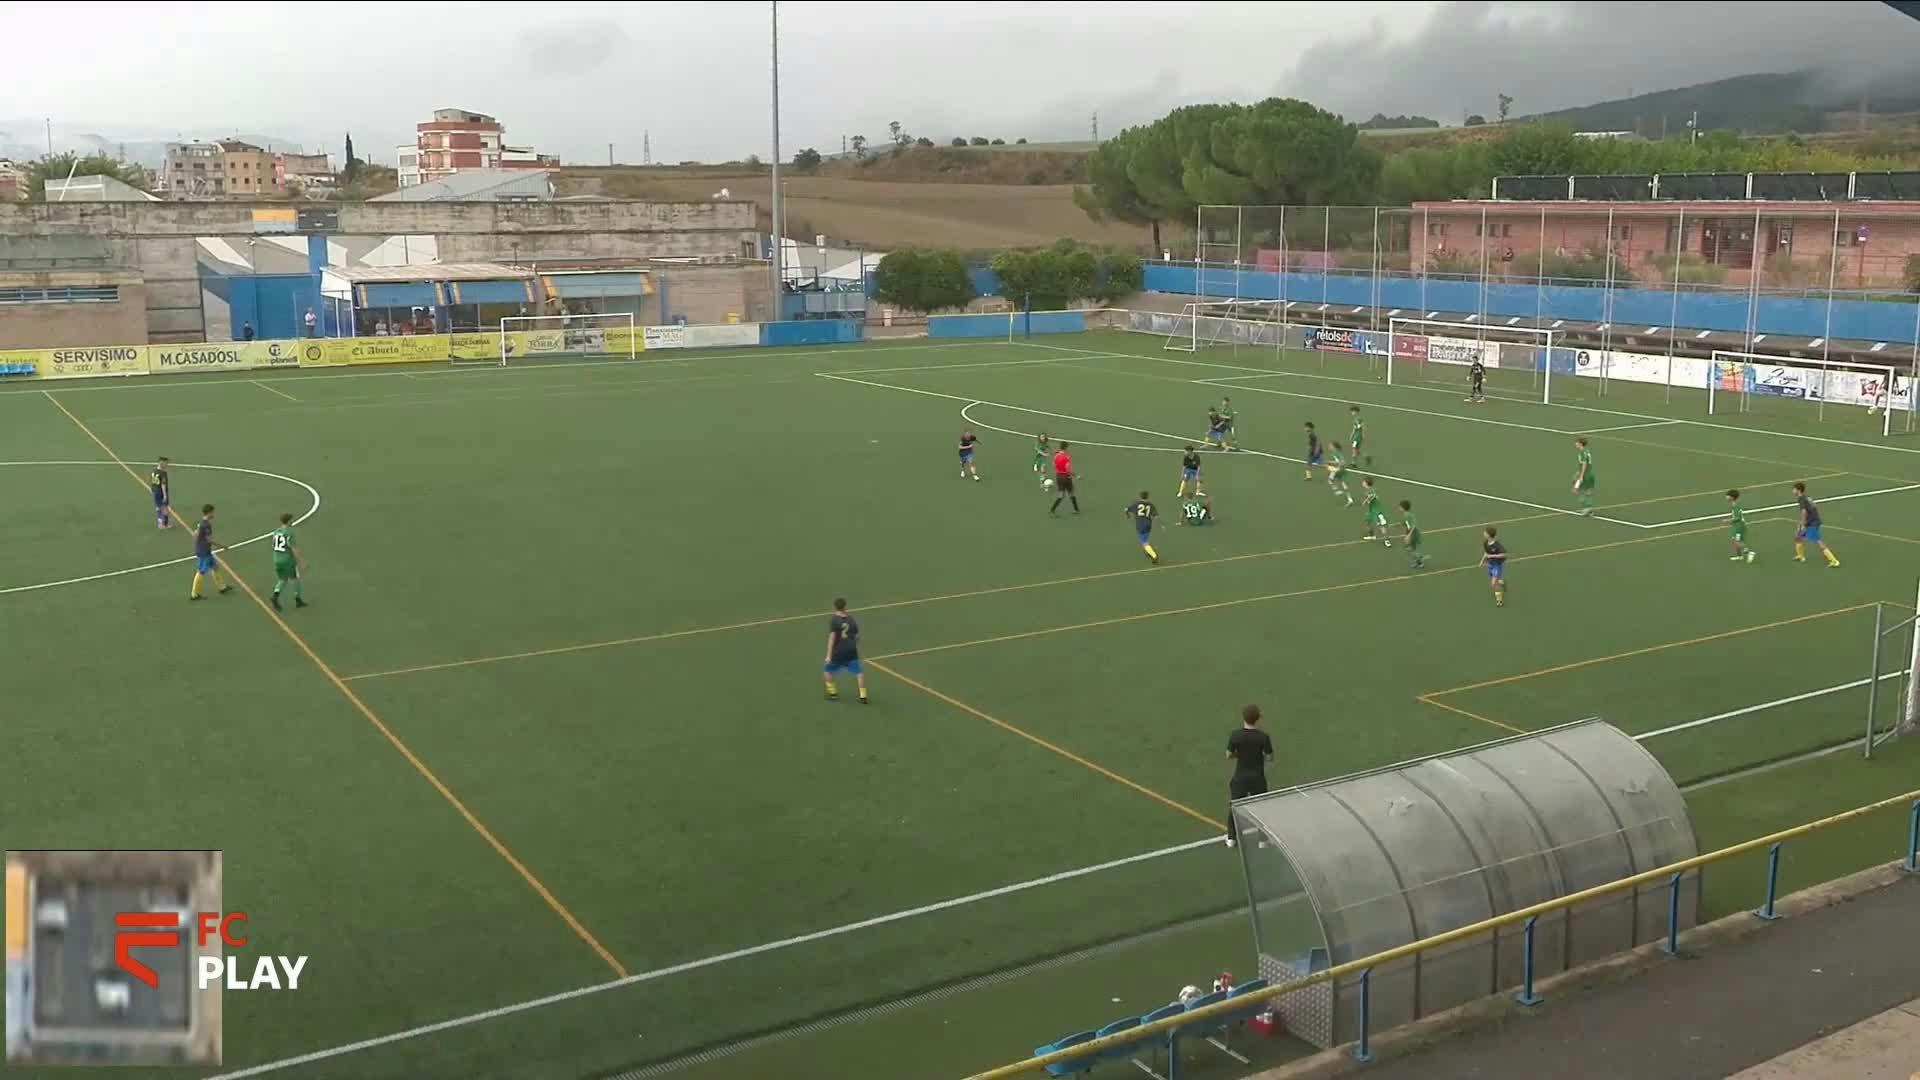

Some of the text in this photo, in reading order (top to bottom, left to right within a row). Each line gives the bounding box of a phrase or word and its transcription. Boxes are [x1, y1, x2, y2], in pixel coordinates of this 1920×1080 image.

[53, 348, 137, 364] SERVISIMO
[1137, 504, 1151, 517] 21
[1185, 505, 1198, 518] 19
[274, 534, 286, 552] 12
[841, 622, 850, 639] 2
